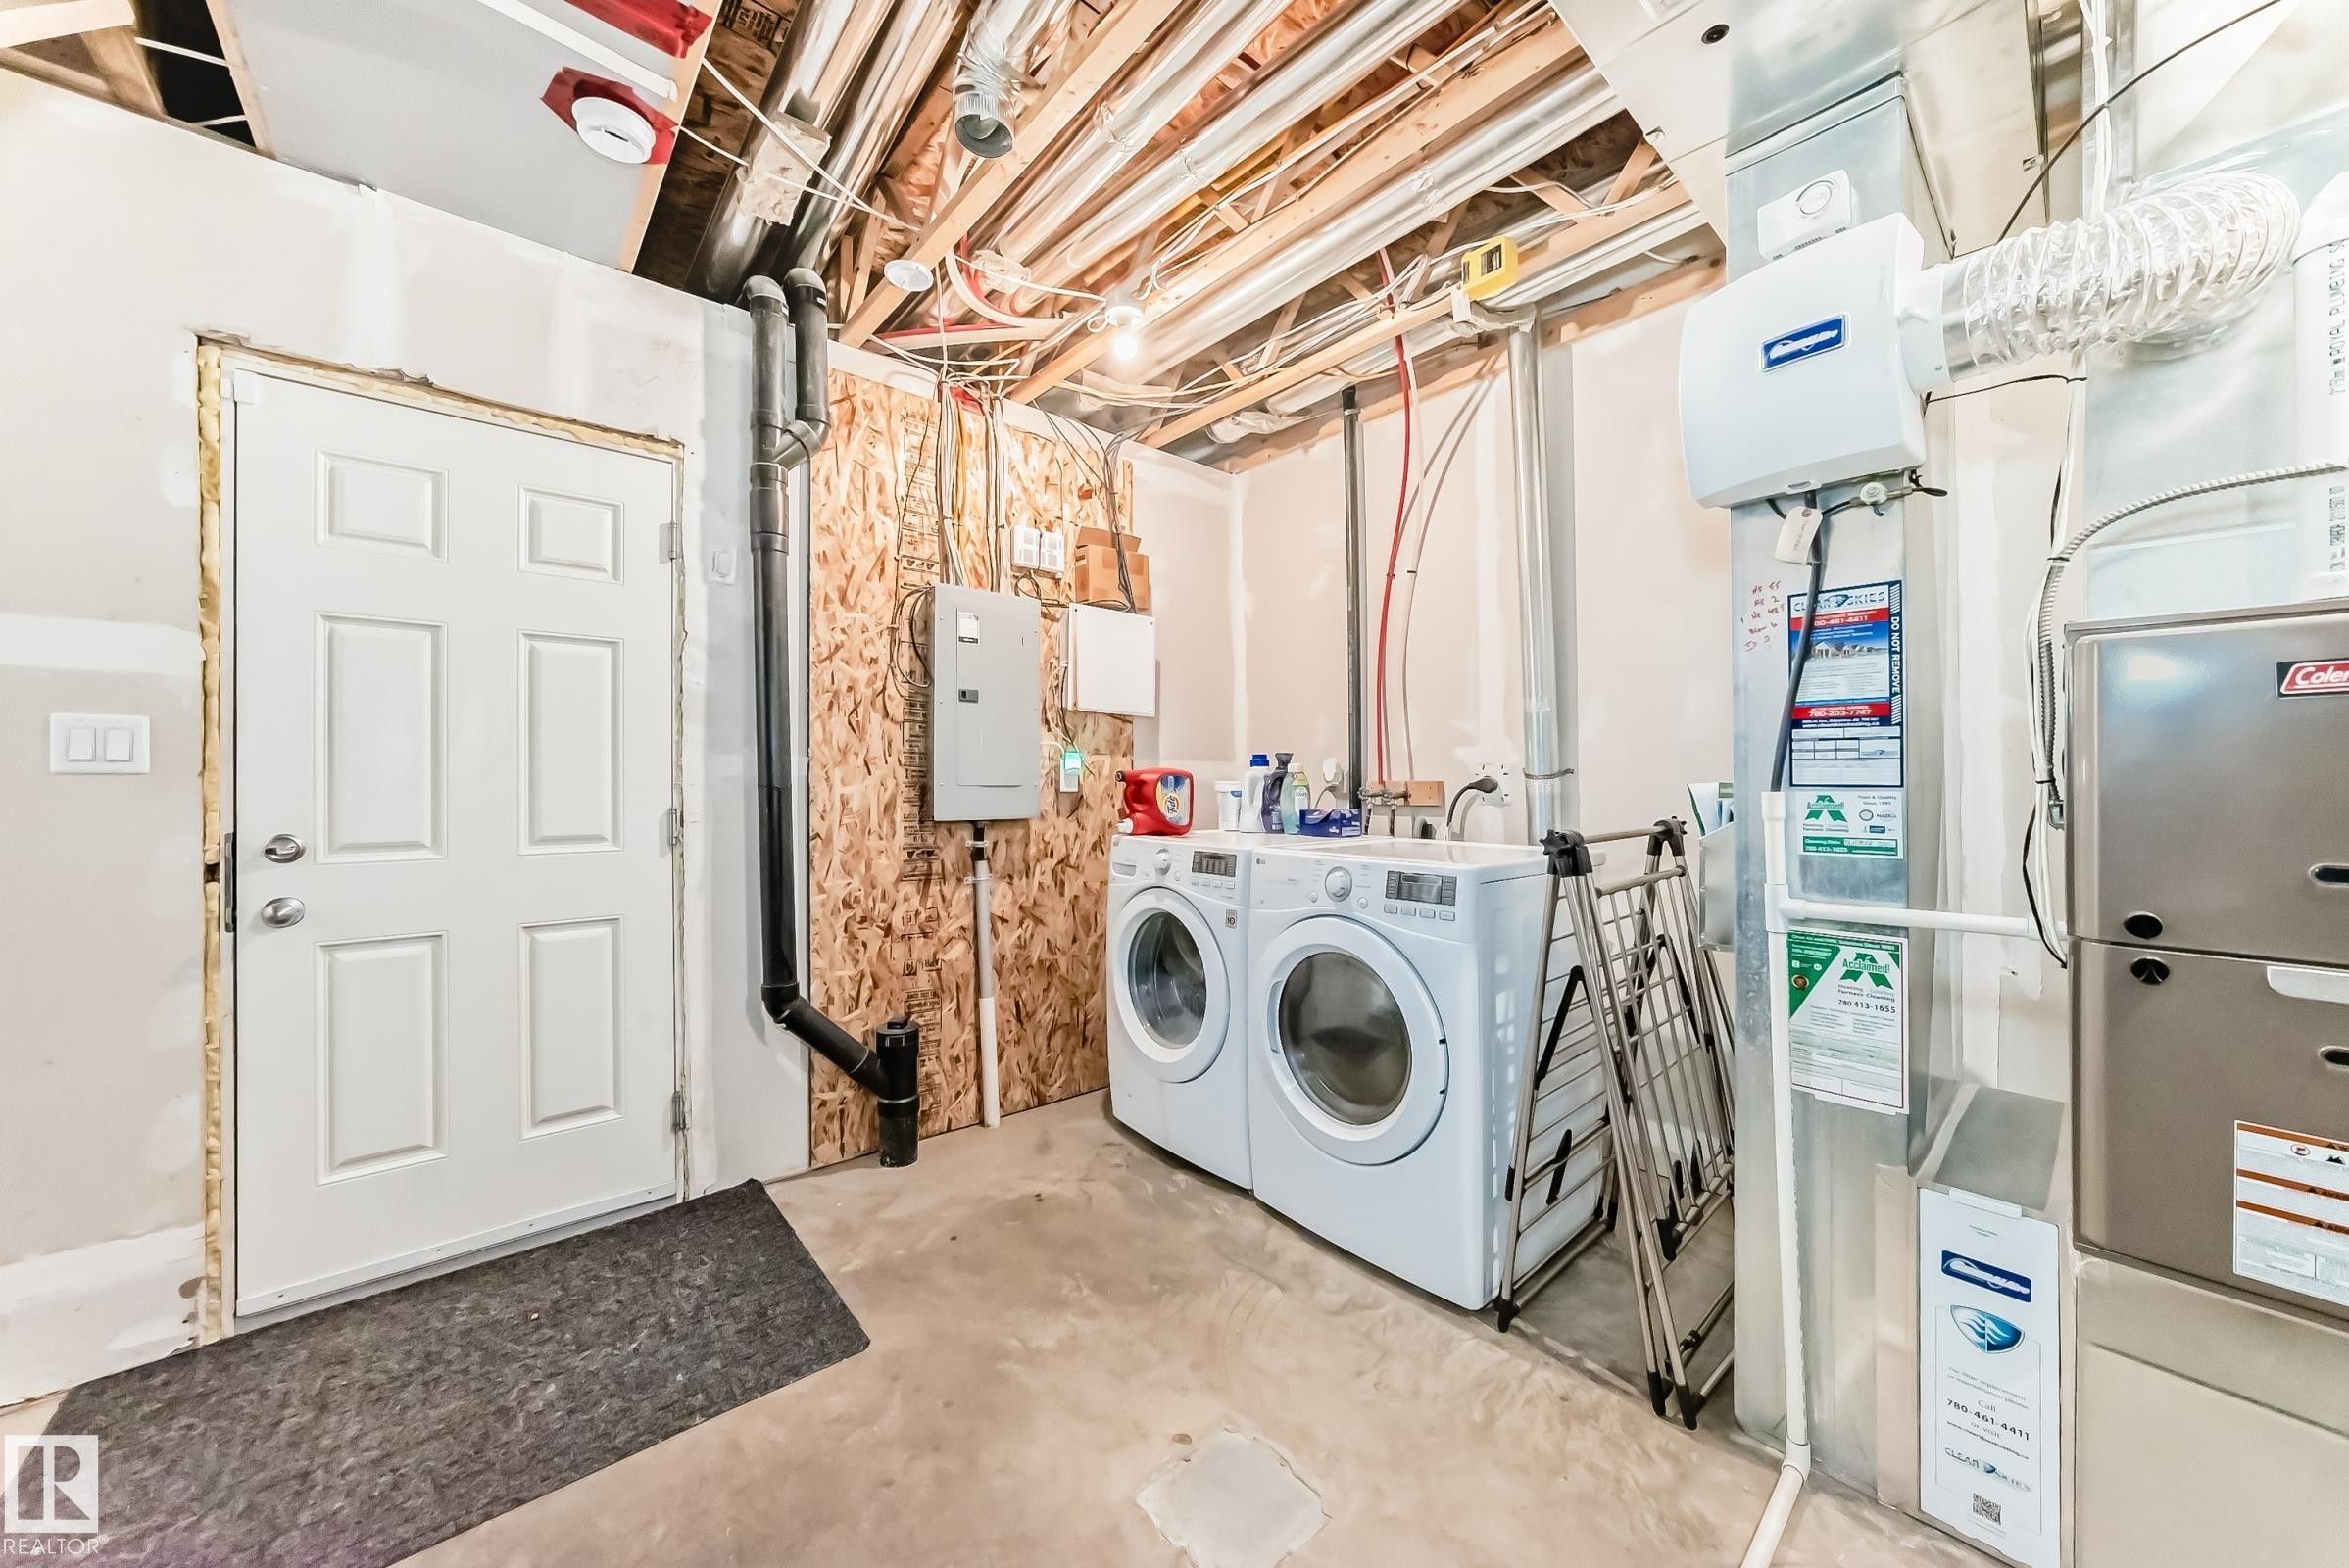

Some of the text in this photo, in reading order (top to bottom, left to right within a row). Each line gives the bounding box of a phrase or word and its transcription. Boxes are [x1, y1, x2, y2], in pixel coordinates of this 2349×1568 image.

[2329, 259, 2345, 316] PLUMBING
[2329, 320, 2345, 356] ROYAL
[1794, 591, 1885, 612] CLAR SKIES
[1891, 616, 1900, 694] DO NOT REMOVE
[1809, 709, 1872, 717] 780-203-7747
[1167, 795, 1178, 814] Tide
[1842, 958, 1890, 974] Acclaimed!
[1866, 993, 1895, 1003] Cleaning
[1978, 1400, 1996, 1413] Call
[1946, 1397, 2030, 1442] 780-461-4411
